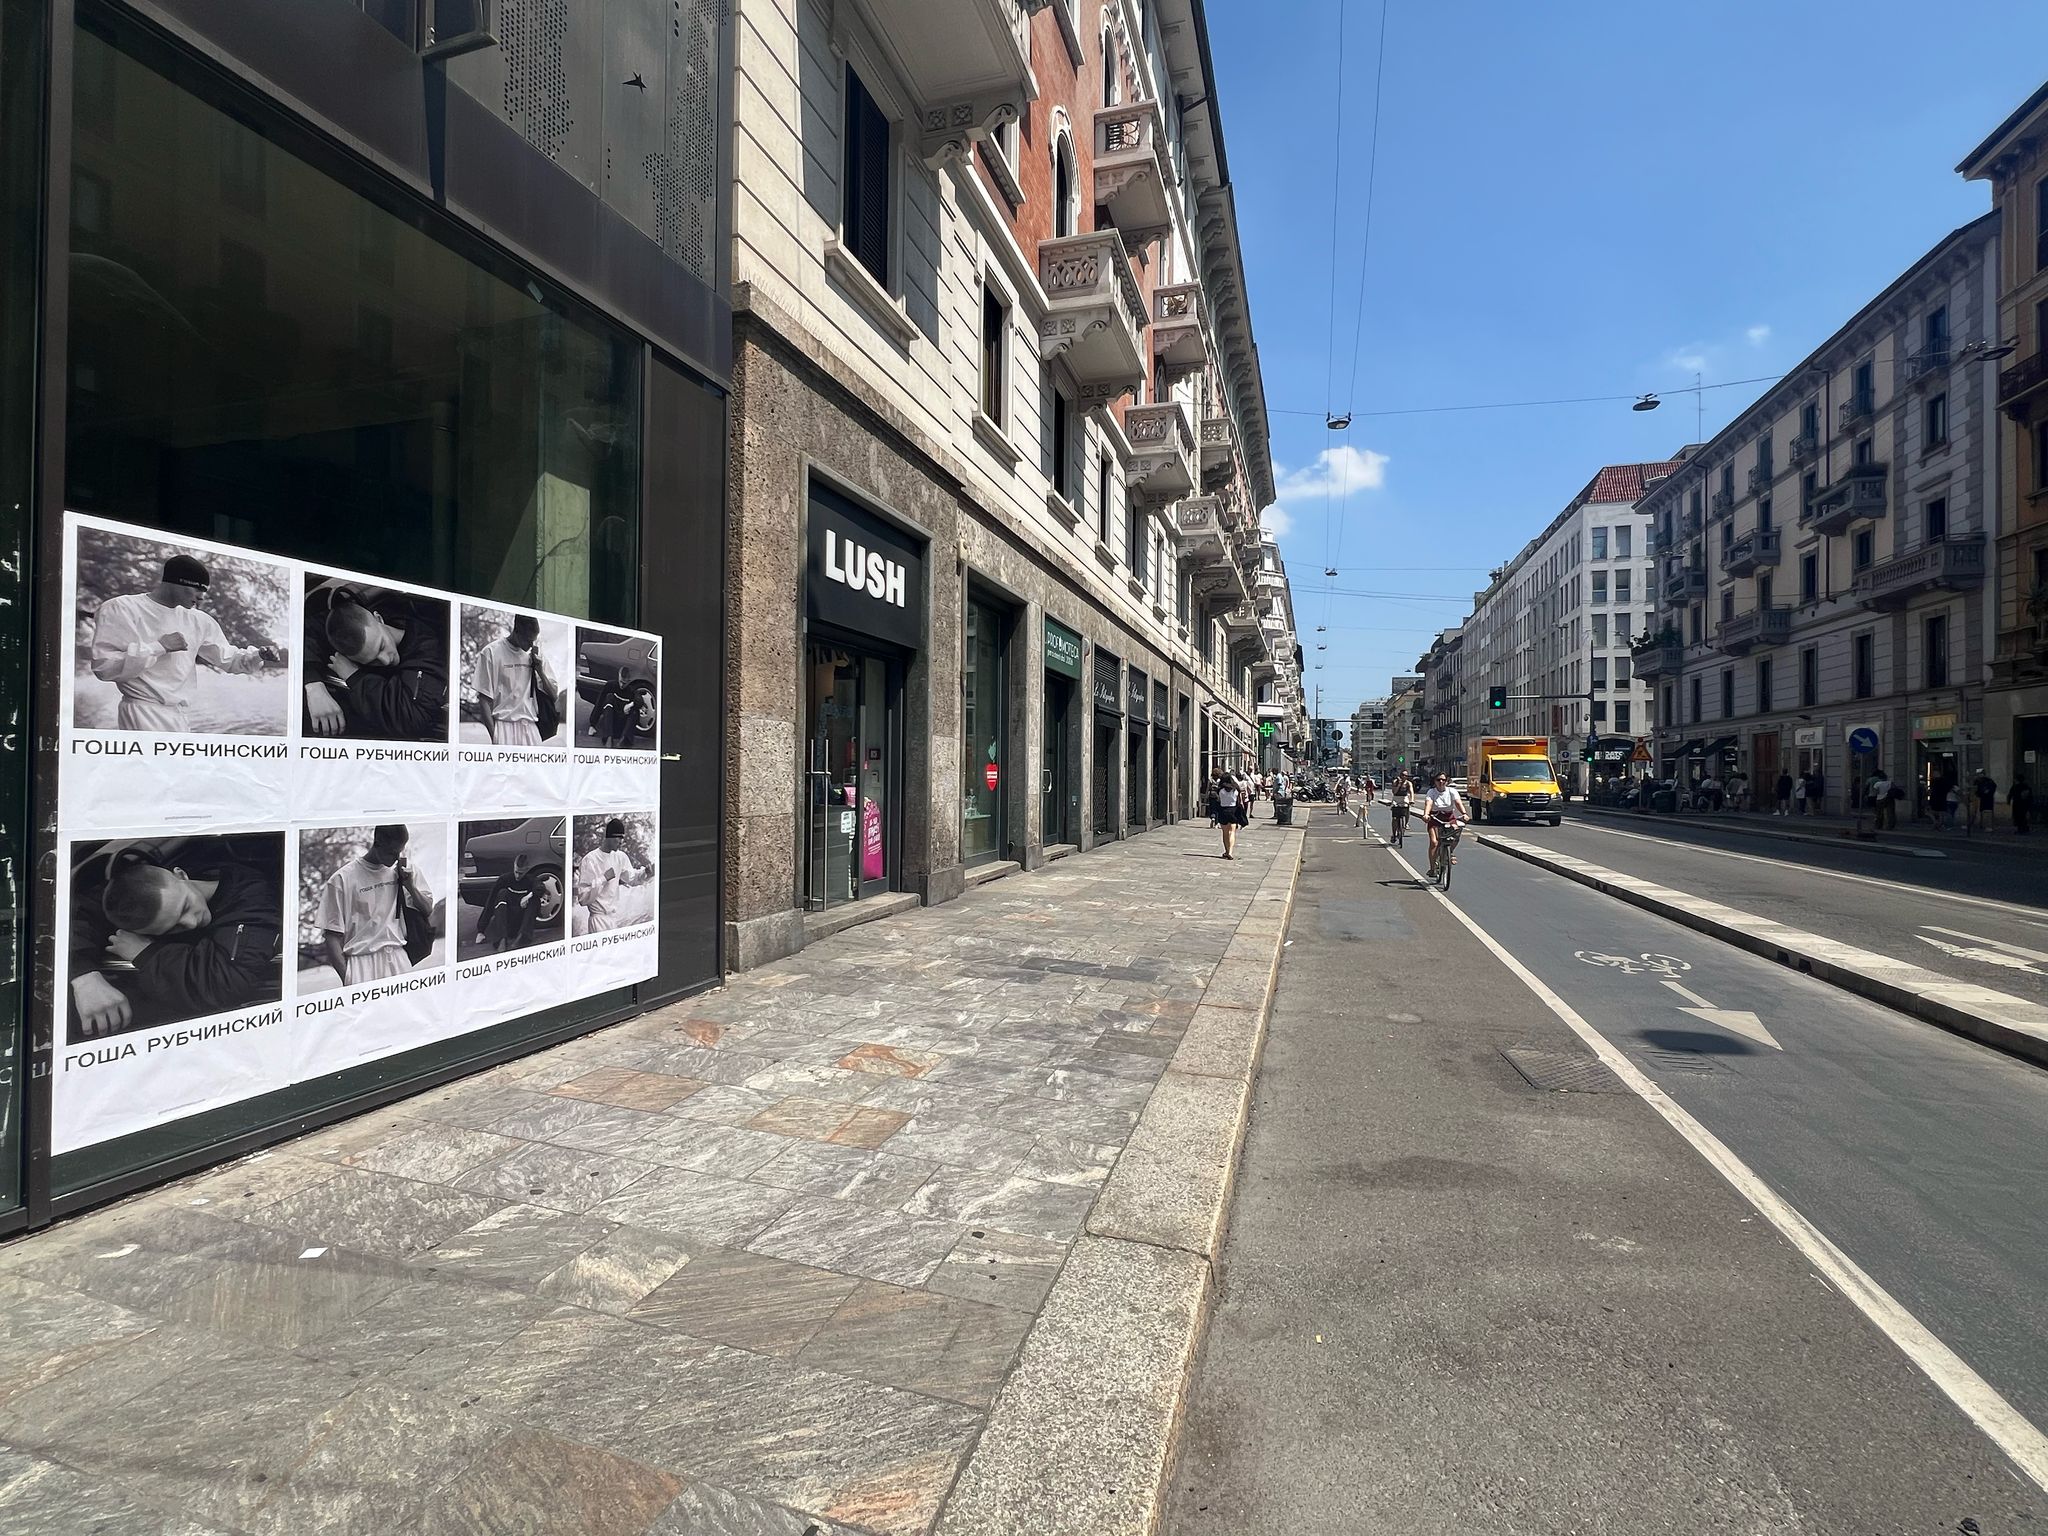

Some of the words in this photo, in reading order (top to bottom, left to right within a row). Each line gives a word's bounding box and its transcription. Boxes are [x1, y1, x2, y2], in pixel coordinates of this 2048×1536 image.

[826, 529, 906, 608] LUSH
[72, 739, 144, 756] ГОША
[154, 742, 288, 759] РУБЧИНСКИЙ
[300, 746, 349, 760] ГОША
[356, 747, 450, 762] РУБЧИНСКИЙ
[458, 751, 494, 763] ГОША
[498, 752, 568, 764] РУБЧИНСКИЙ
[573, 754, 601, 764] ГОША
[604, 756, 658, 766] РУБЧИНСКИЙ
[570, 940, 599, 954] ГОША
[601, 927, 656, 947] РУБЧИНСКИЙ
[456, 963, 492, 981] ГОША
[496, 946, 567, 971] РУБЧИНСКИЙ
[296, 996, 345, 1018] ГОША
[351, 971, 447, 1005] РУБЧИНСКИЙ
[65, 1043, 137, 1072] ГОША
[147, 1009, 284, 1053] РУБЧИНСКИЙ
